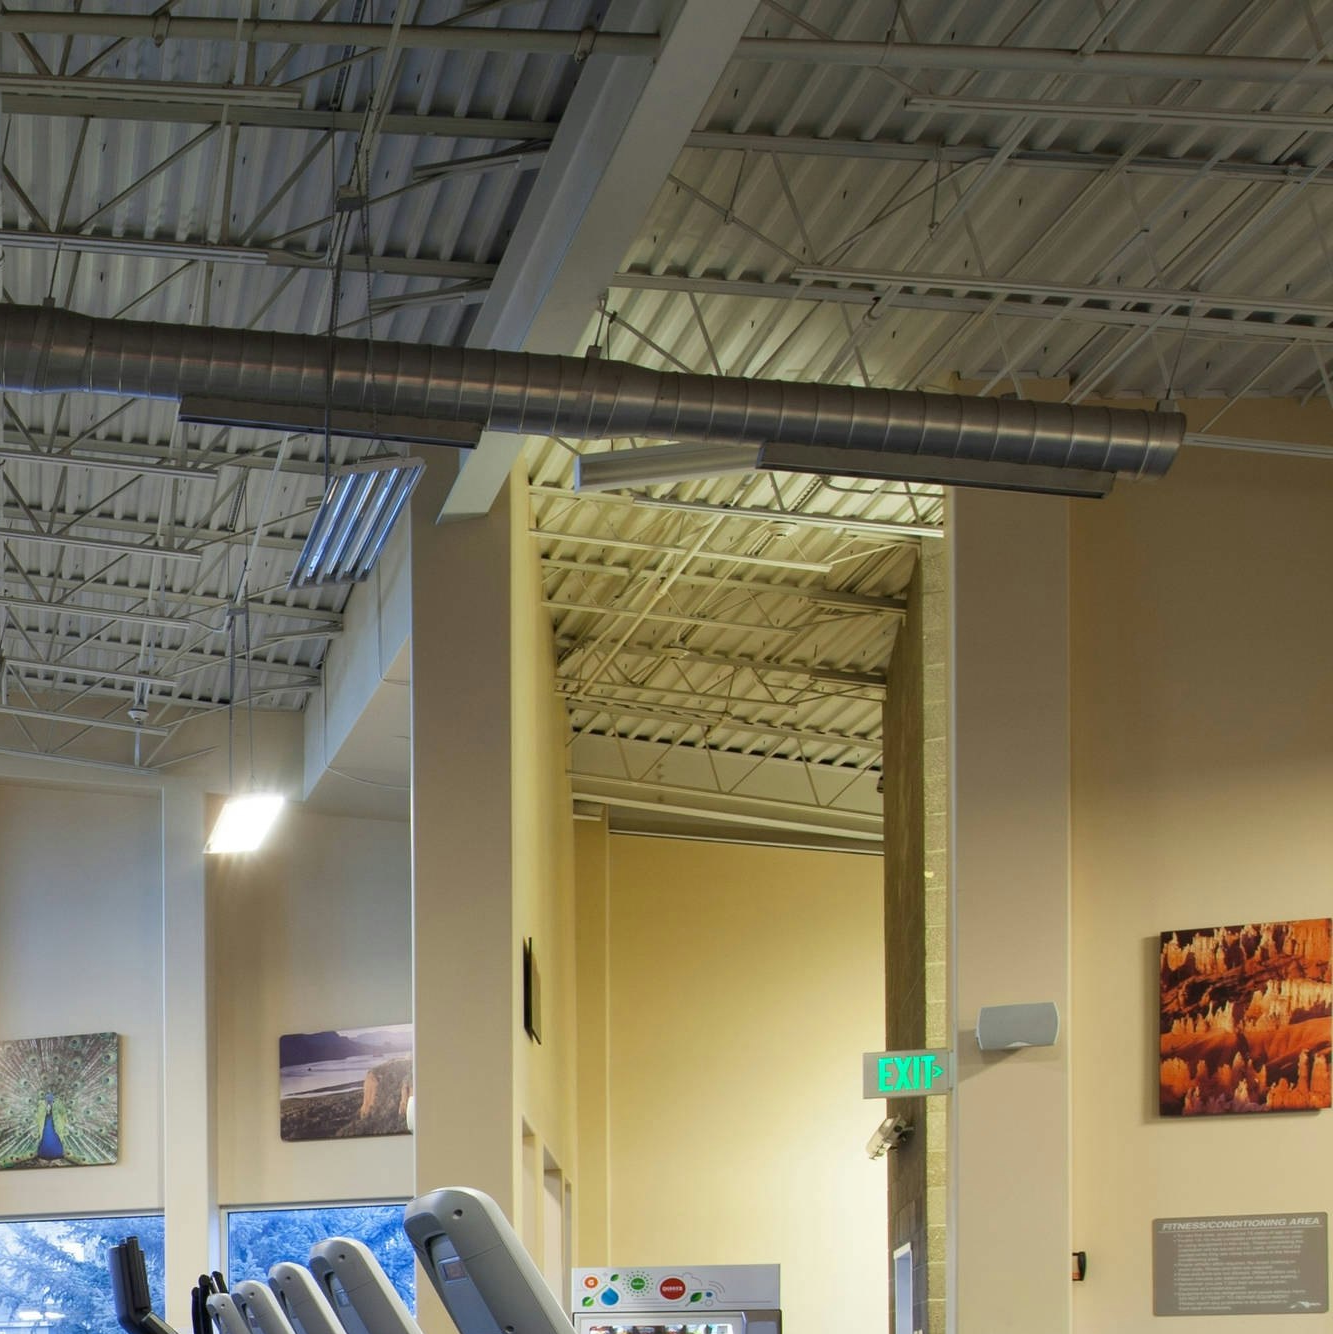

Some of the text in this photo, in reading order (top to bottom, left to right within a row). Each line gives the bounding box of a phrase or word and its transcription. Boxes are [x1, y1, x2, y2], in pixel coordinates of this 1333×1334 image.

[878, 1054, 936, 1092] EXIT
[1162, 1217, 1320, 1231] FITNESS/CONDITIONING AREA
